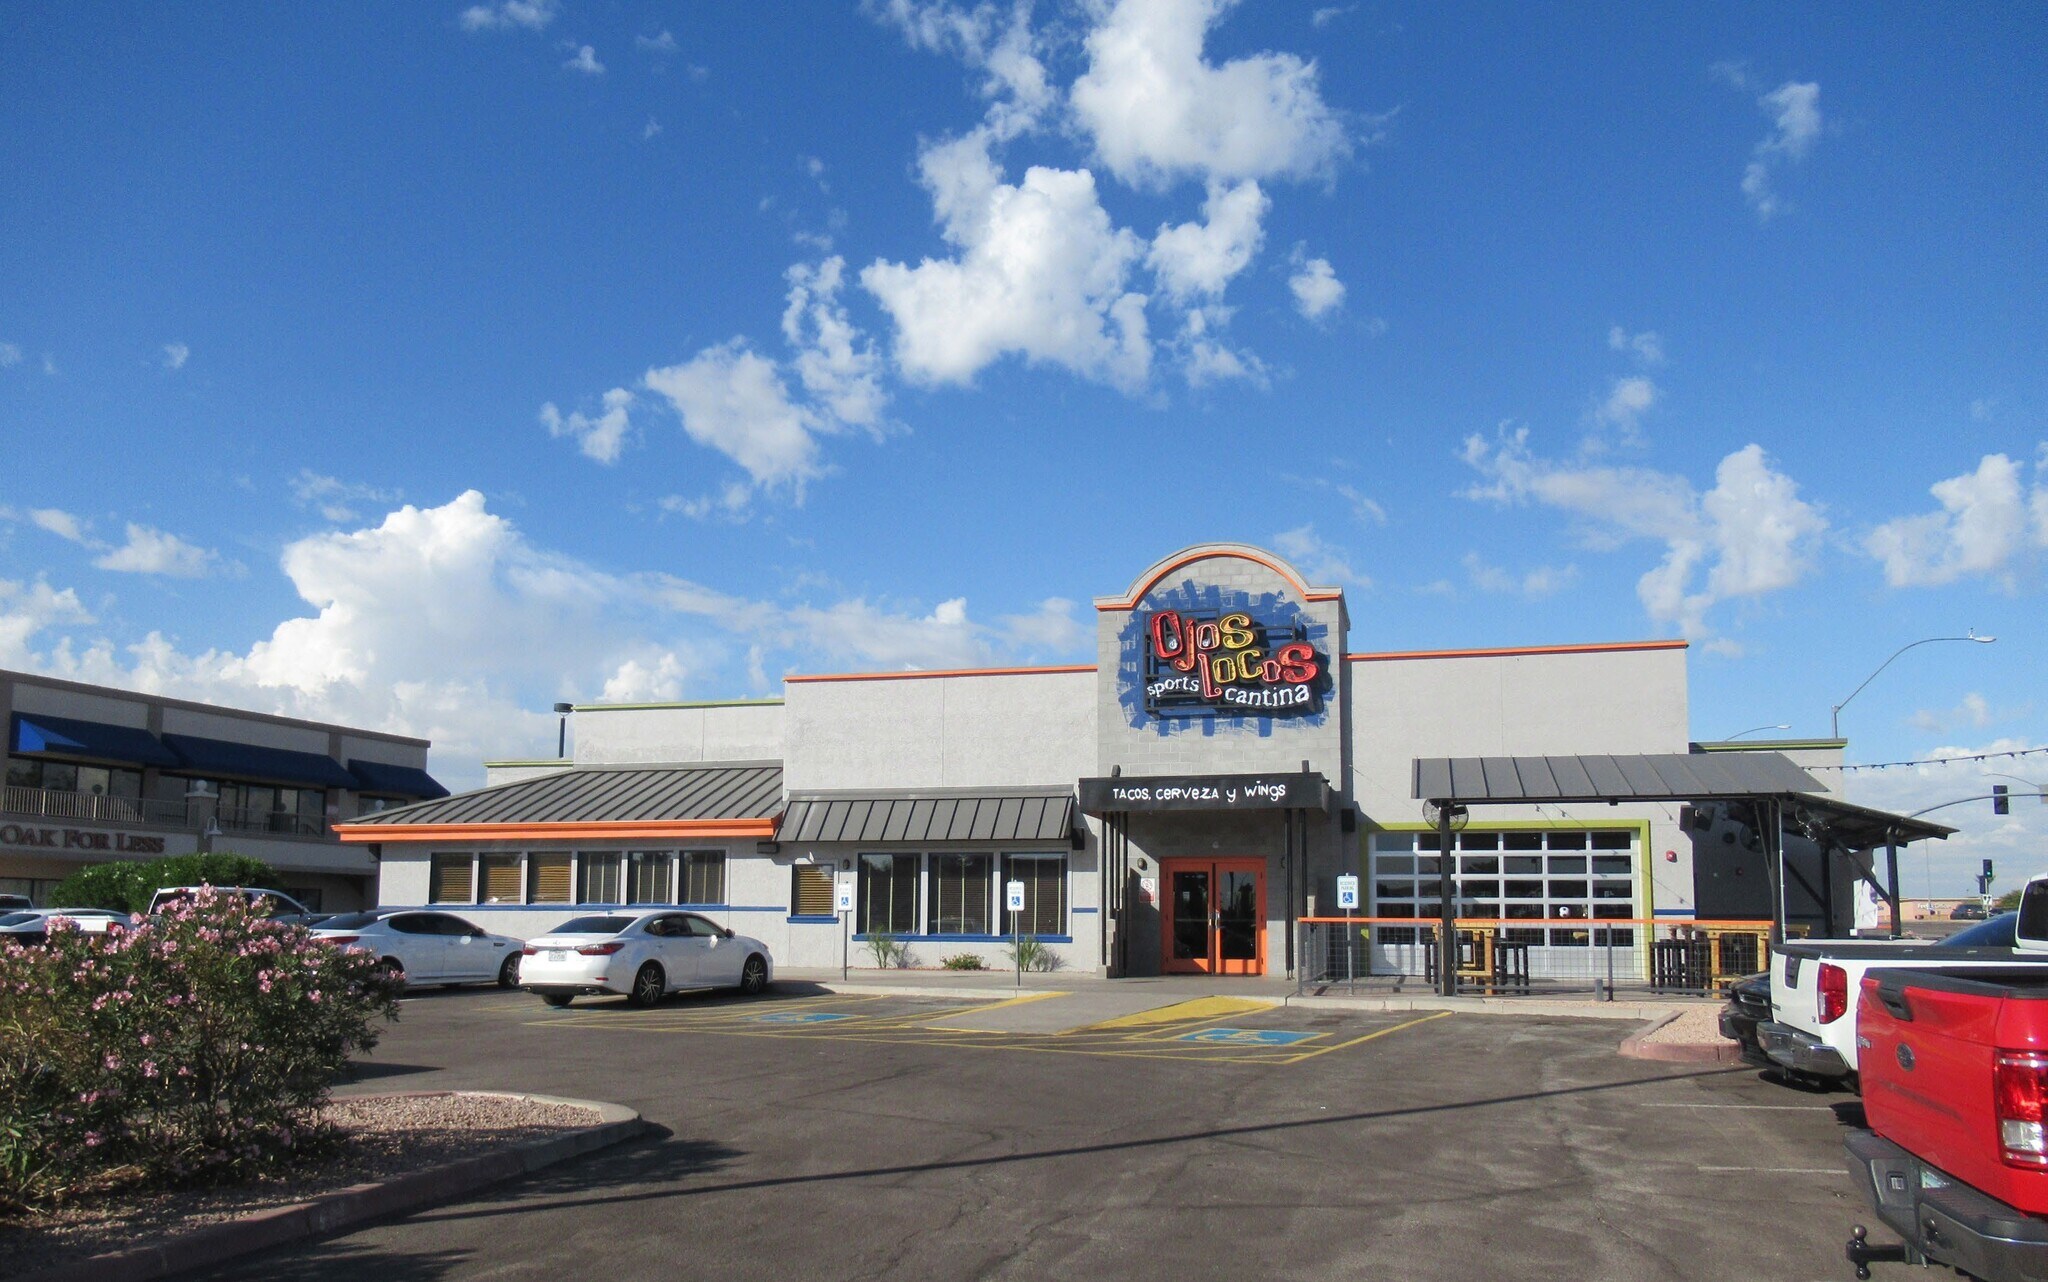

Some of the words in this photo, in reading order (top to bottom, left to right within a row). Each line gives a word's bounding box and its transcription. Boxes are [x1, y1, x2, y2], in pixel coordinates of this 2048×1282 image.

[1152, 610, 1254, 671] Ojos
[1147, 676, 1199, 697] sports
[1225, 684, 1310, 707] cantina
[1113, 788, 1151, 800] TACOS,
[1226, 789, 1236, 803] y
[0, 824, 58, 848] OAK
[63, 829, 111, 850] FOR
[116, 833, 165, 853] LESS
